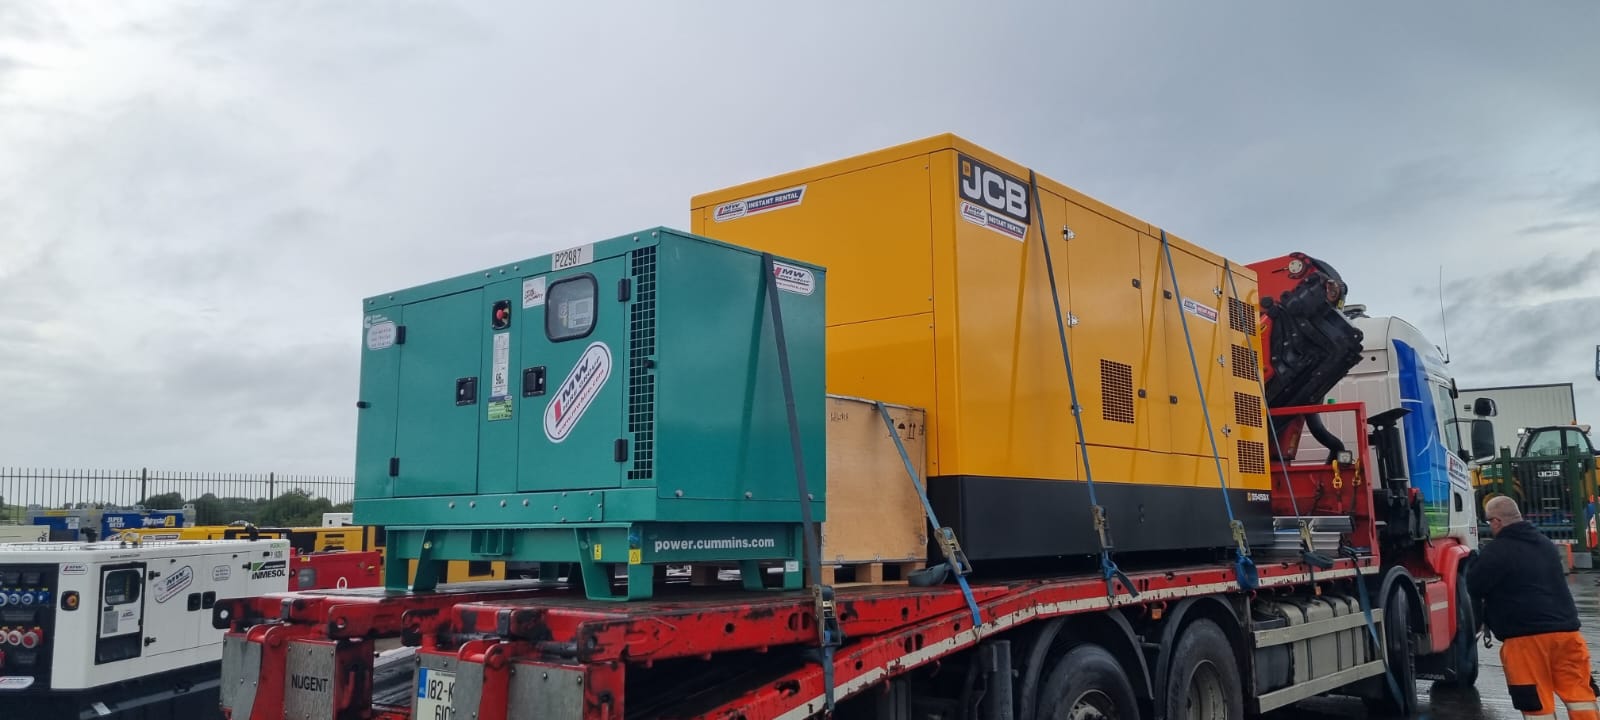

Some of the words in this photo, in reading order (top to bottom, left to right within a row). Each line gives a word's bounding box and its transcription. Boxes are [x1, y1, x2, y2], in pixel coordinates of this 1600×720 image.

[748, 198, 774, 209] INSTANT
[775, 192, 799, 202] RENTAL
[962, 166, 1027, 218] JCB
[554, 248, 582, 269] P22987
[781, 268, 805, 278] MW
[561, 358, 589, 403] MW
[654, 536, 775, 553] power.cummins.com
[251, 569, 286, 580] INMESOL
[291, 674, 329, 693] NUGENT
